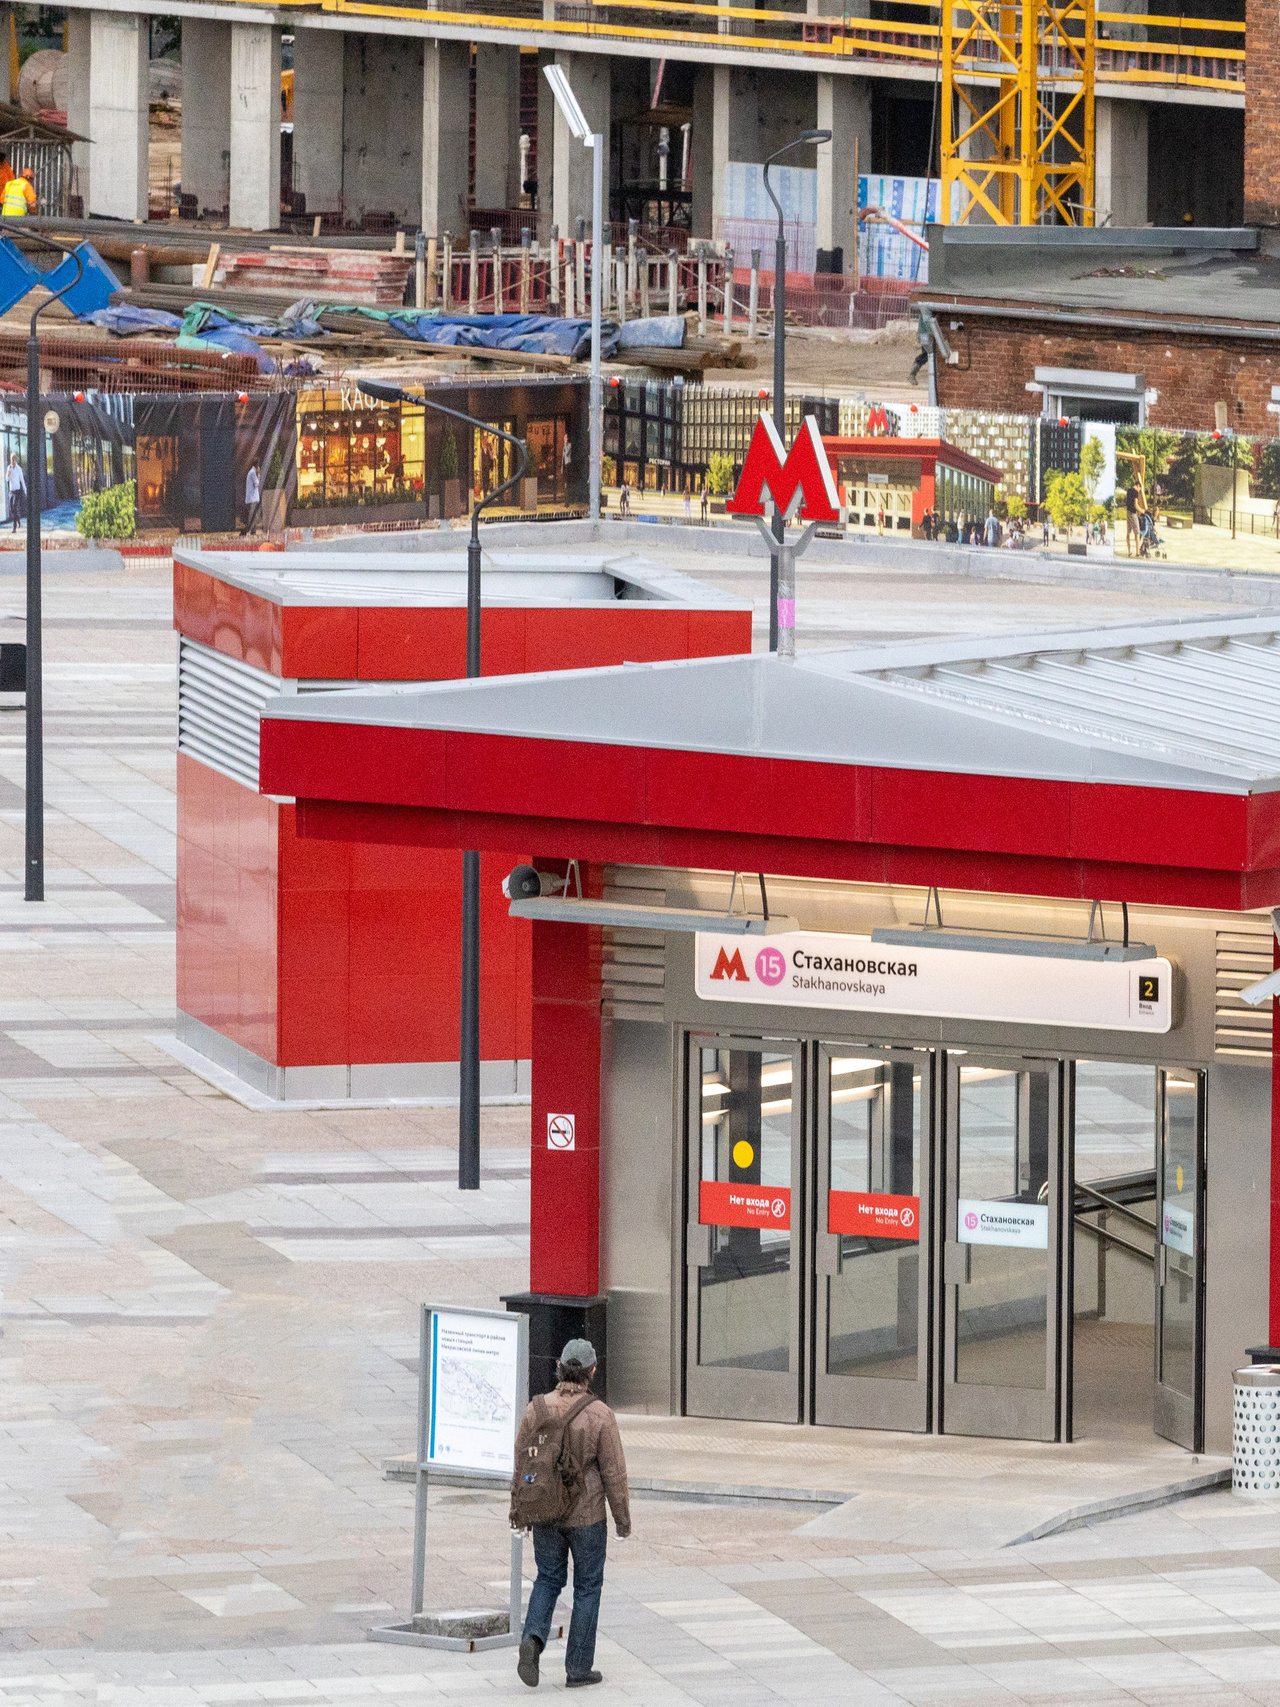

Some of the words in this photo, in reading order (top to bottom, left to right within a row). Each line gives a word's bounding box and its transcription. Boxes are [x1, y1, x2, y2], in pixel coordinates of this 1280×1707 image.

[760, 955, 782, 978] 15
[792, 950, 918, 977] Стахановская
[792, 975, 886, 997] Stakhanovskaya
[1144, 981, 1153, 997] 2
[729, 1194, 745, 1206] Нет
[746, 1197, 770, 1209] входа
[746, 1207, 755, 1215] No
[858, 1203, 874, 1215] Нет
[874, 1206, 899, 1218] входа
[875, 1216, 884, 1225] No
[980, 1213, 1035, 1227] Стахановская
